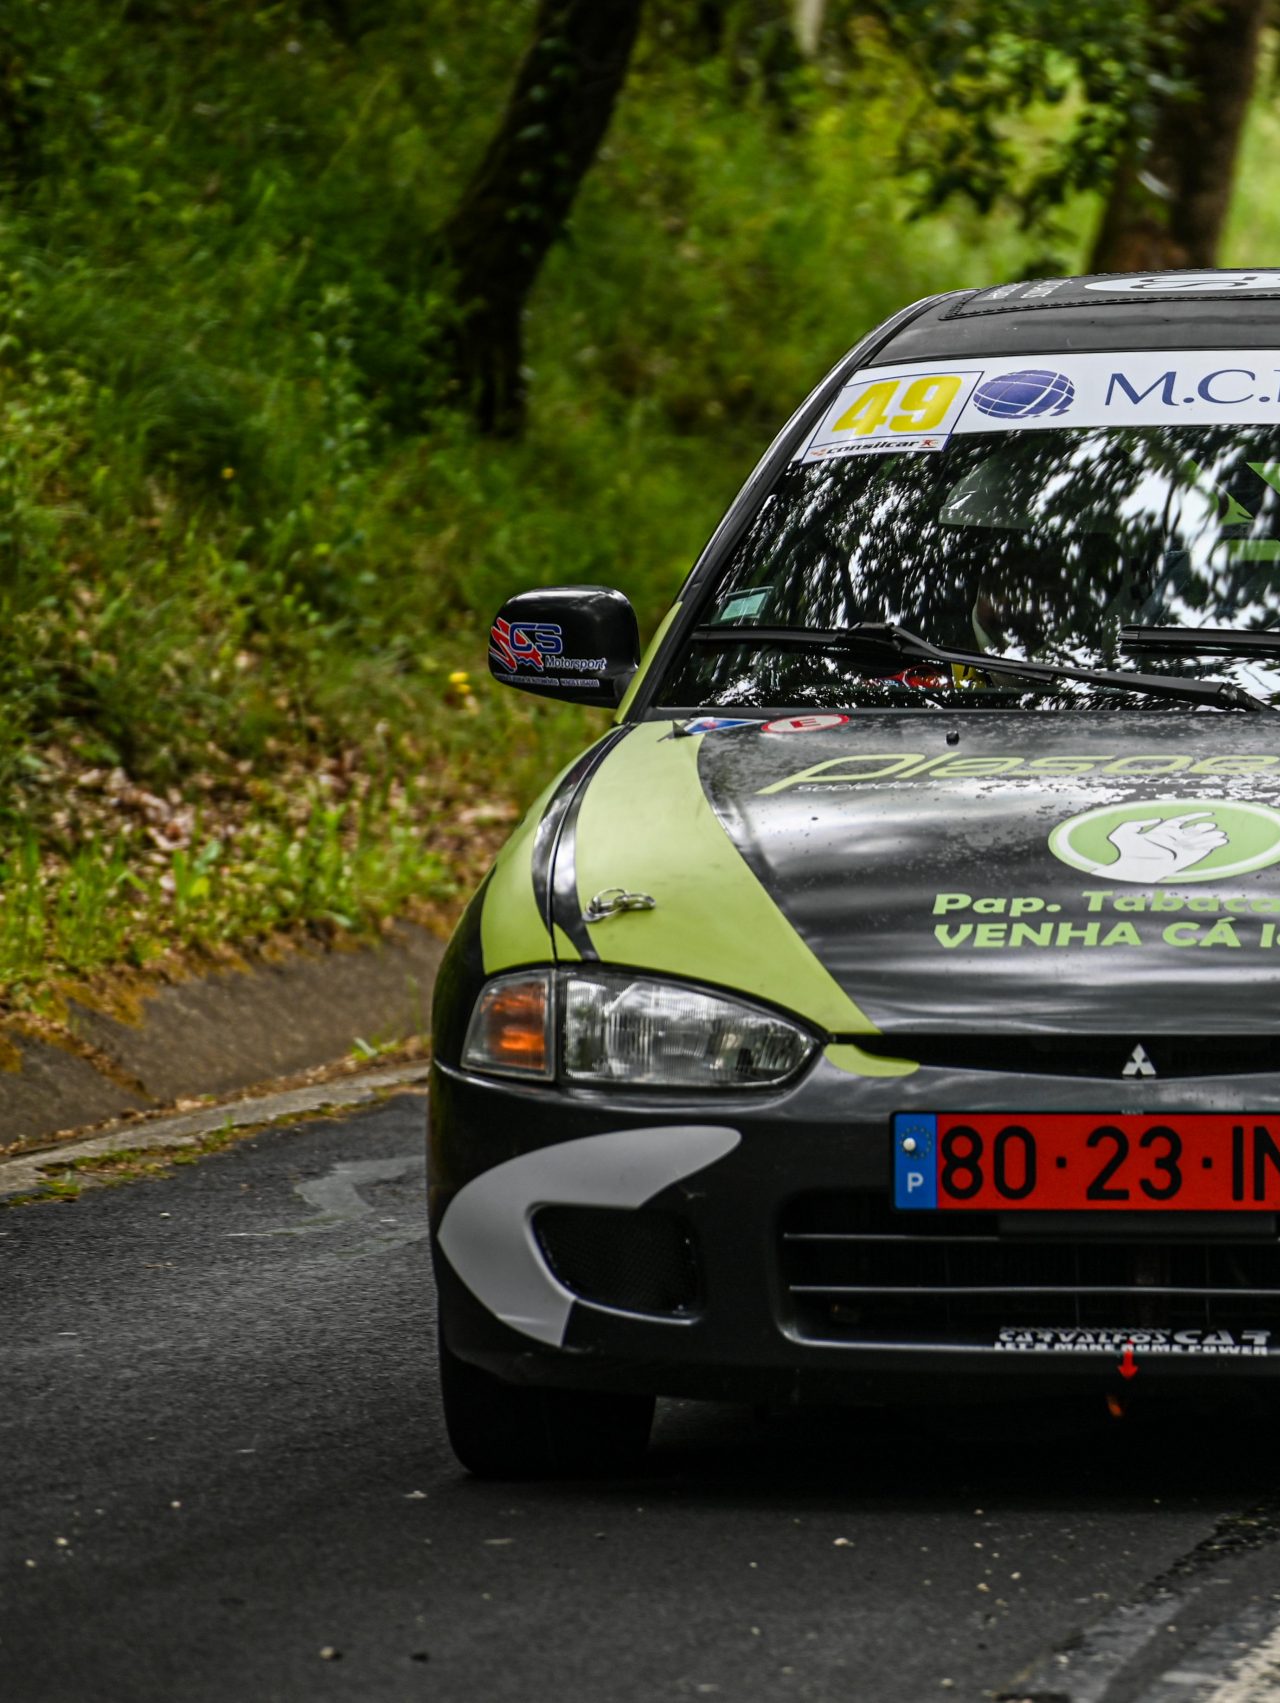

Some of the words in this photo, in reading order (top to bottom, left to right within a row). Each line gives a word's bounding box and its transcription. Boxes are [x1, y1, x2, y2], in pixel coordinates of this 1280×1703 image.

[831, 376, 962, 435] 49
[826, 439, 920, 455] consilcar
[545, 655, 607, 672] Motorsport
[932, 892, 1062, 917] Pap.
[934, 922, 1142, 948] VENHA
[1162, 916, 1241, 948] CÁ
[907, 1171, 924, 1193] P
